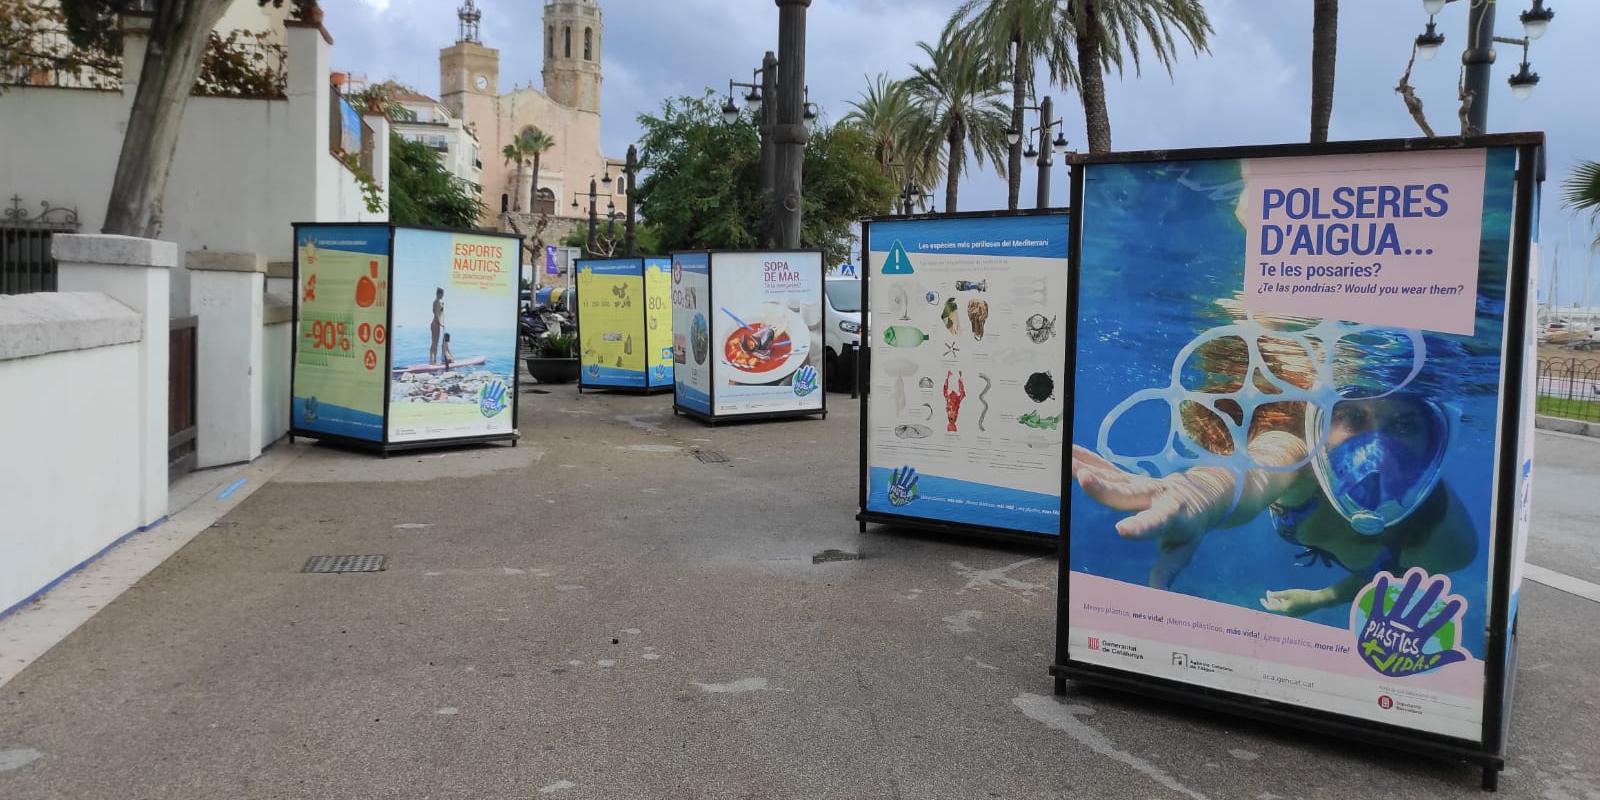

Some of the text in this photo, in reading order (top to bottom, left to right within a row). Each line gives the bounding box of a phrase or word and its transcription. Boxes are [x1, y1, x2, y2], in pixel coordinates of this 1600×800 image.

[1262, 183, 1449, 220] POLSERES
[1260, 222, 1433, 256] D'AIGUA...
[455, 243, 502, 259] ESPORTS
[764, 261, 789, 271] SOPA
[1260, 262, 1381, 280] Te les posaries?
[764, 272, 776, 281] DE
[1257, 282, 1274, 295] ¿Te
[1276, 283, 1290, 293] las
[1344, 283, 1377, 294] Would
[1379, 286, 1398, 296] you
[1401, 286, 1427, 295] wear
[1429, 285, 1465, 296] them?
[304, 320, 350, 351] -90%
[1132, 612, 1147, 620] més
[1147, 614, 1164, 622] vida!
[1226, 627, 1242, 636] más
[1243, 630, 1260, 640] vida!
[1314, 642, 1334, 652] more
[1335, 644, 1350, 654] life!
